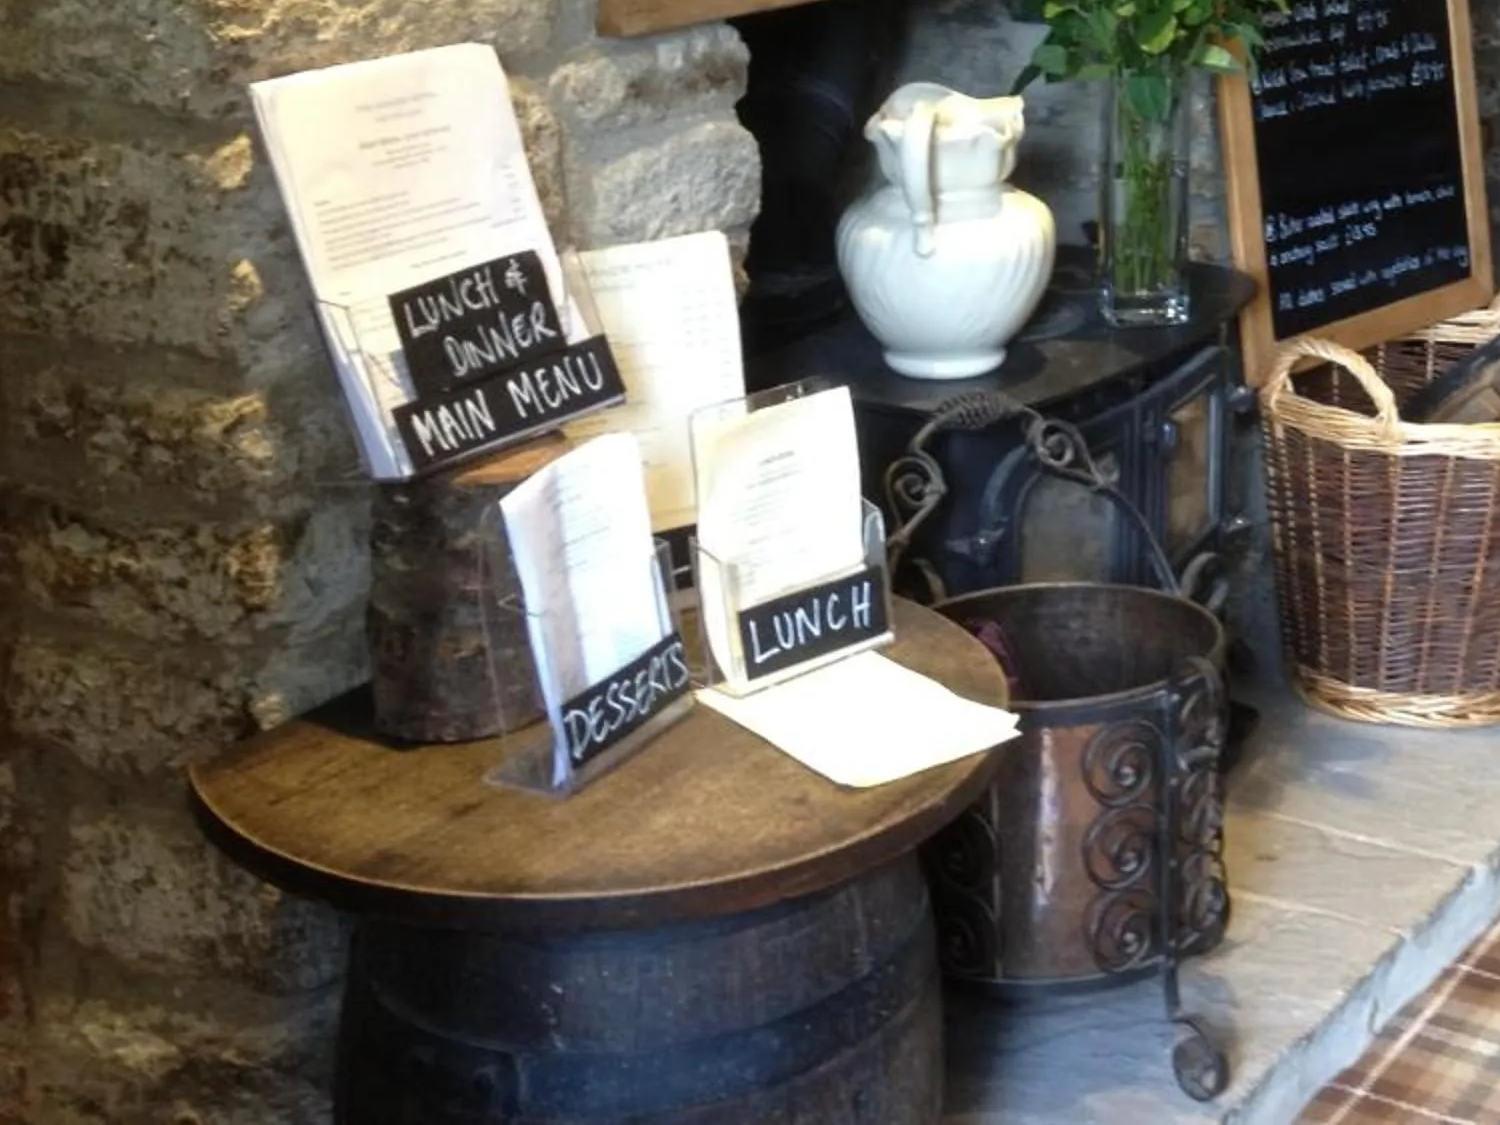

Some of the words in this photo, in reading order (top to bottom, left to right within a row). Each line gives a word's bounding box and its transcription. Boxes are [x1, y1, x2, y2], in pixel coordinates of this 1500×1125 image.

[403, 265, 500, 339] LUNCH
[443, 300, 557, 377] DINNER
[411, 388, 497, 457] MAIN
[506, 351, 604, 419] MENU
[750, 581, 872, 664] LUNCH
[562, 640, 690, 761] DESSERTS
